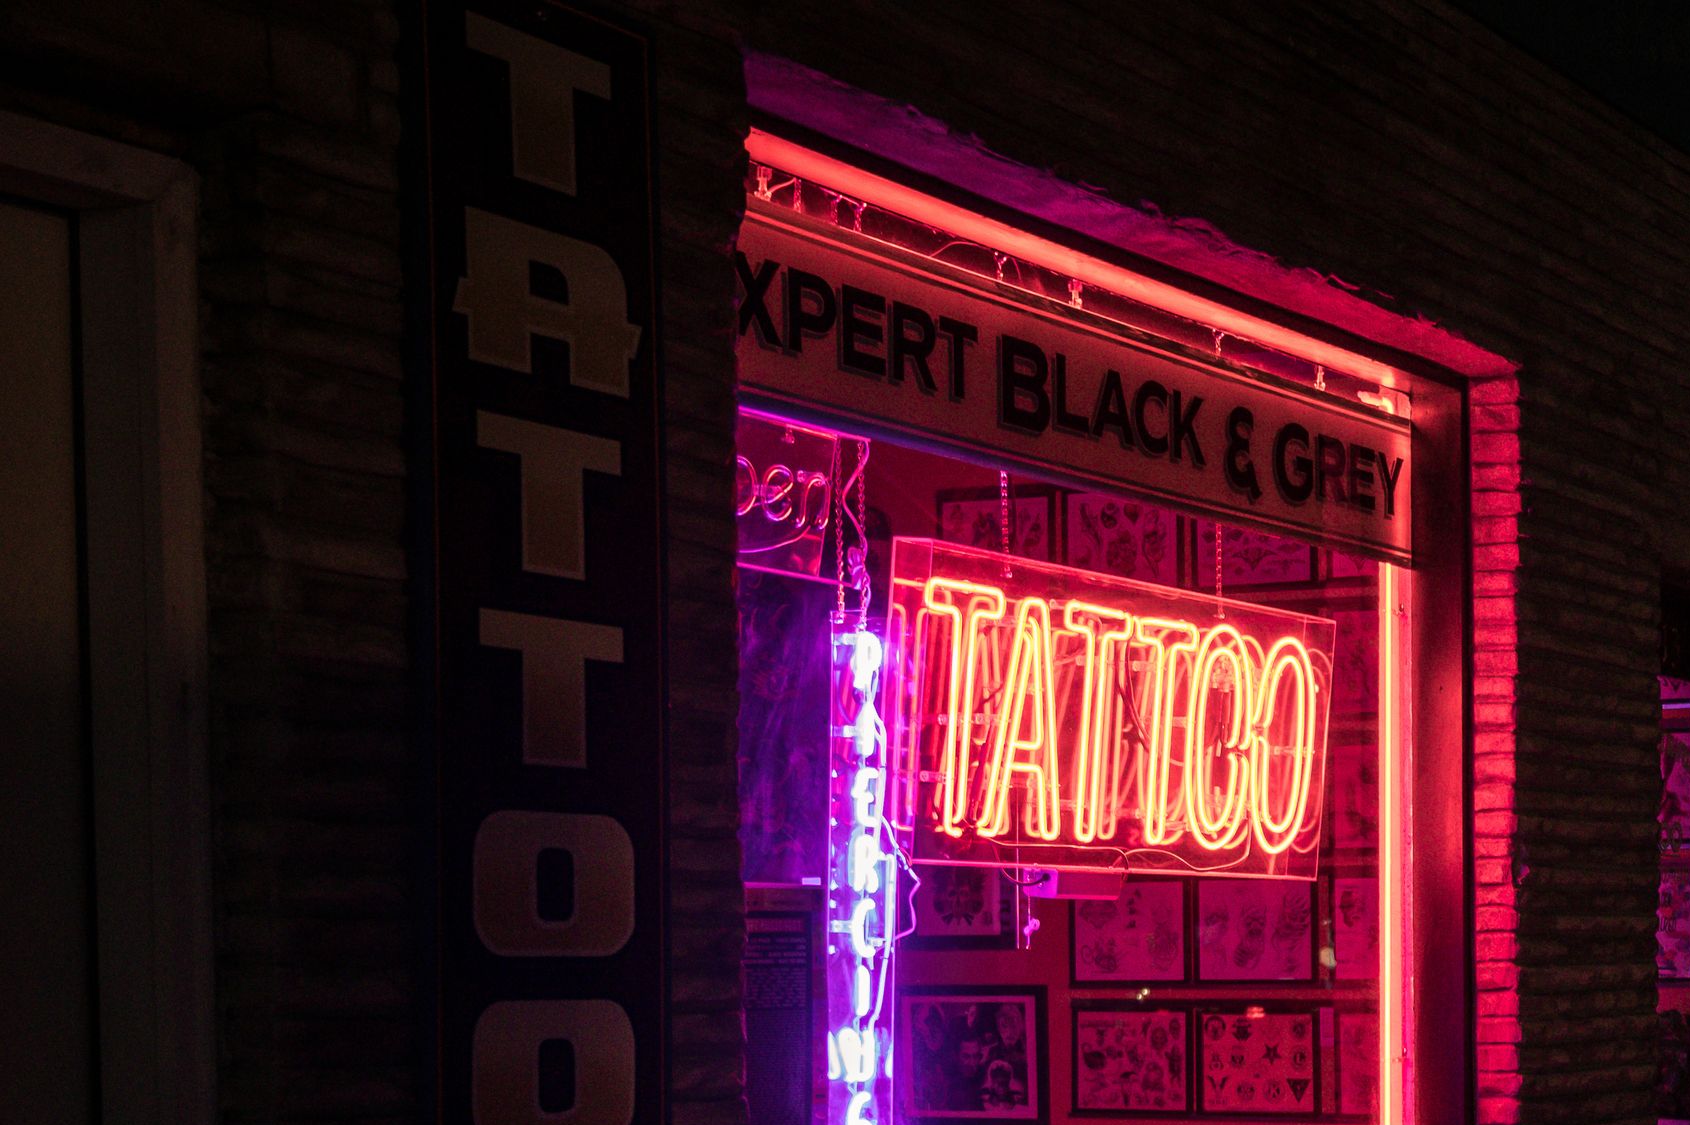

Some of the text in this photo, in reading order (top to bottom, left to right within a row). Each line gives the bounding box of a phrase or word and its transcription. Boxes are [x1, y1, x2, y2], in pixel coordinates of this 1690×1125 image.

[735, 251, 1404, 518] XPERT BLACK & GREY
[925, 577, 1317, 854] TATTOO
